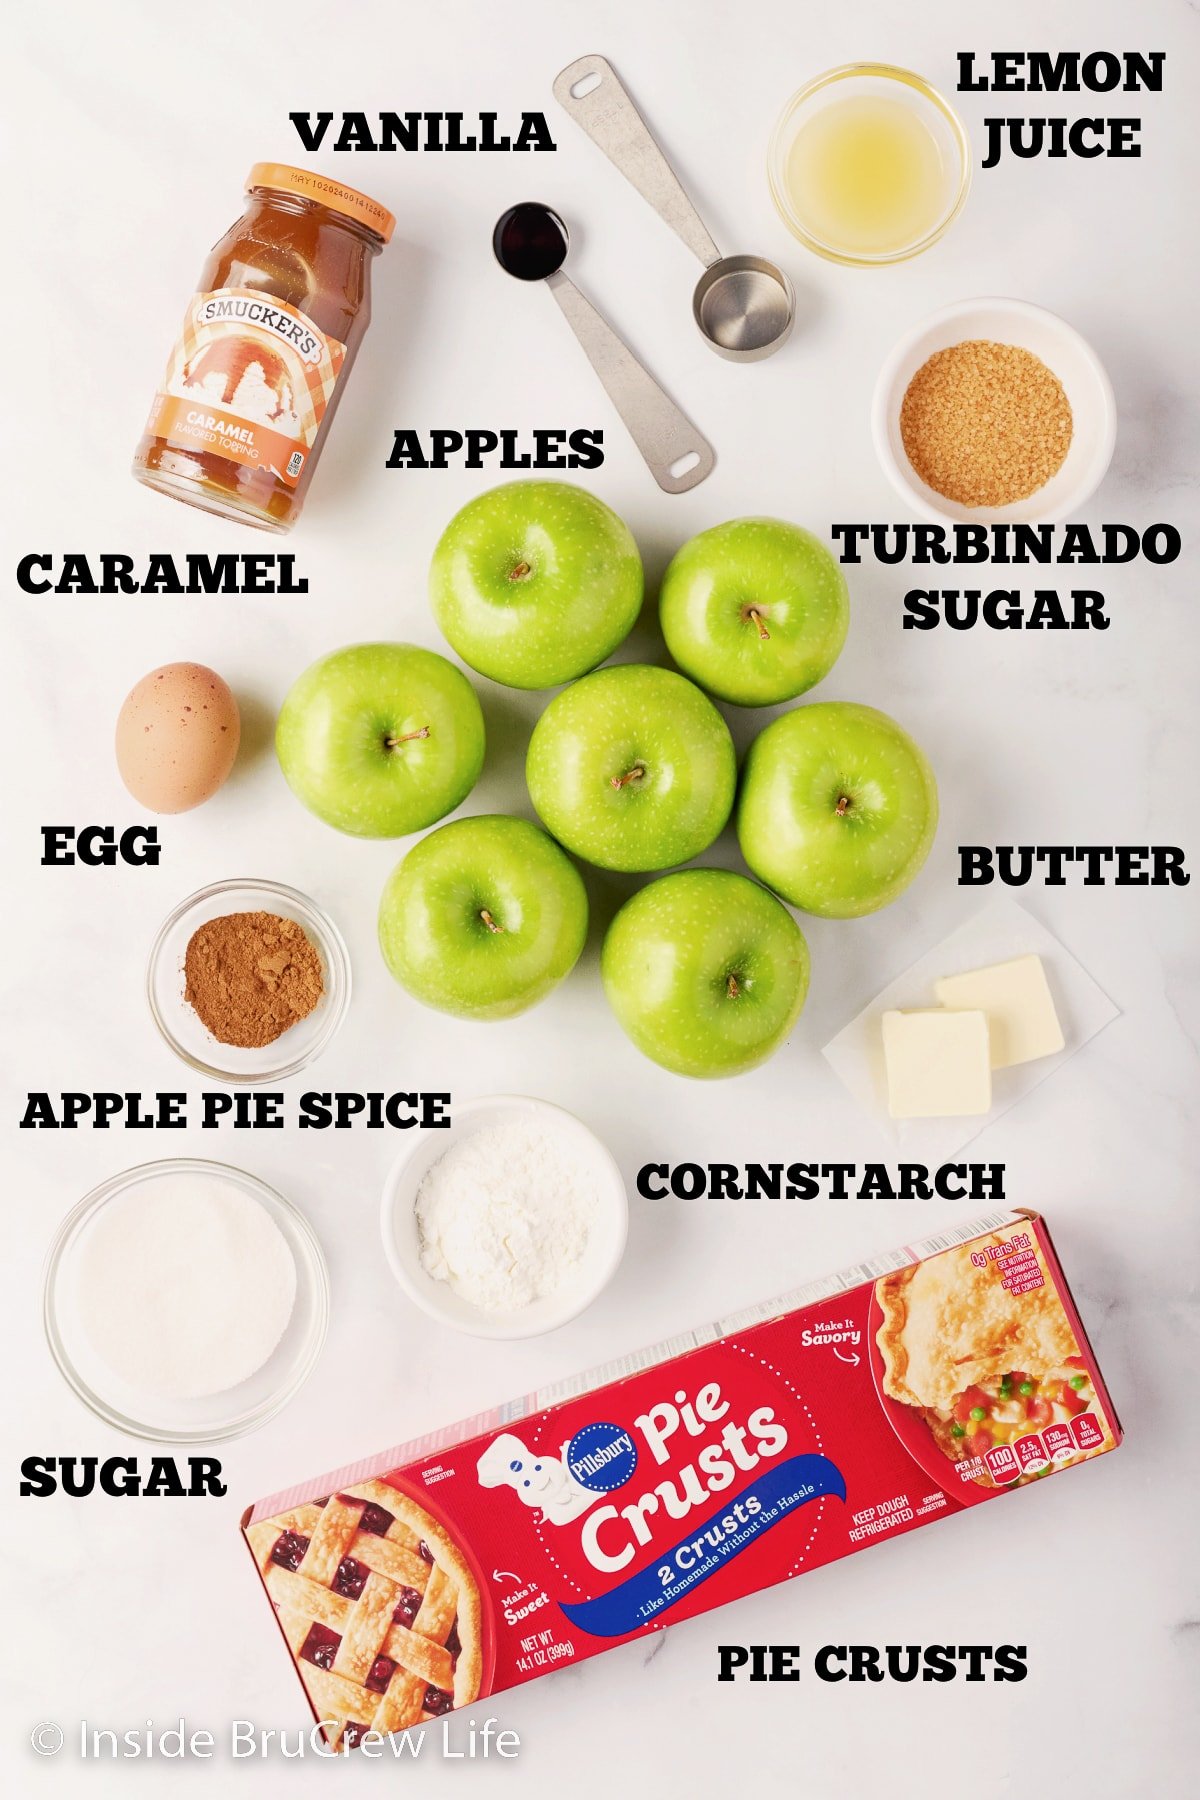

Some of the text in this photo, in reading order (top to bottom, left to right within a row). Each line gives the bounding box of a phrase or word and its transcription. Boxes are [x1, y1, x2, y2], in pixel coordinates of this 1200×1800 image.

[206, 301, 317, 354] SMUCKER'S
[175, 422, 217, 443] FLAVORED
[186, 411, 254, 446] CARAMEL
[219, 435, 260, 459] TOPPING
[971, 1233, 1031, 1267] 0g Trans Fat
[1008, 1250, 1034, 1265] NUTRITION
[1004, 1259, 1038, 1277] INFORMATION
[1013, 1268, 1041, 1285] SATURATED
[1021, 1277, 1044, 1291] CONTENT
[814, 1319, 854, 1332] Make It
[801, 1329, 861, 1346] Savory
[634, 1383, 730, 1465] Pie
[570, 1433, 633, 1482] Pillsbury
[954, 1456, 982, 1473] PER 1/8
[989, 1449, 1013, 1468] 100
[421, 1465, 443, 1478] SERVING
[424, 1468, 455, 1486] SUGGESTION
[960, 1466, 985, 1482] CRUST
[993, 1462, 1017, 1476] CALORIES
[581, 1407, 788, 1573] Crusts
[922, 1491, 944, 1505] SERVING
[852, 1494, 909, 1526] KEEP DOUGH
[916, 1499, 947, 1516] SUGGESTION
[848, 1508, 914, 1542] REFRIGERATED
[640, 1484, 814, 1616] Like Homemade Without the Hassle
[657, 1496, 762, 1586] 2 Crusts
[501, 1582, 538, 1608] Make It
[504, 1591, 550, 1626] Sweet
[520, 1629, 553, 1653] NET WT
[515, 1640, 575, 1672] 14.1 OZ (399g)
